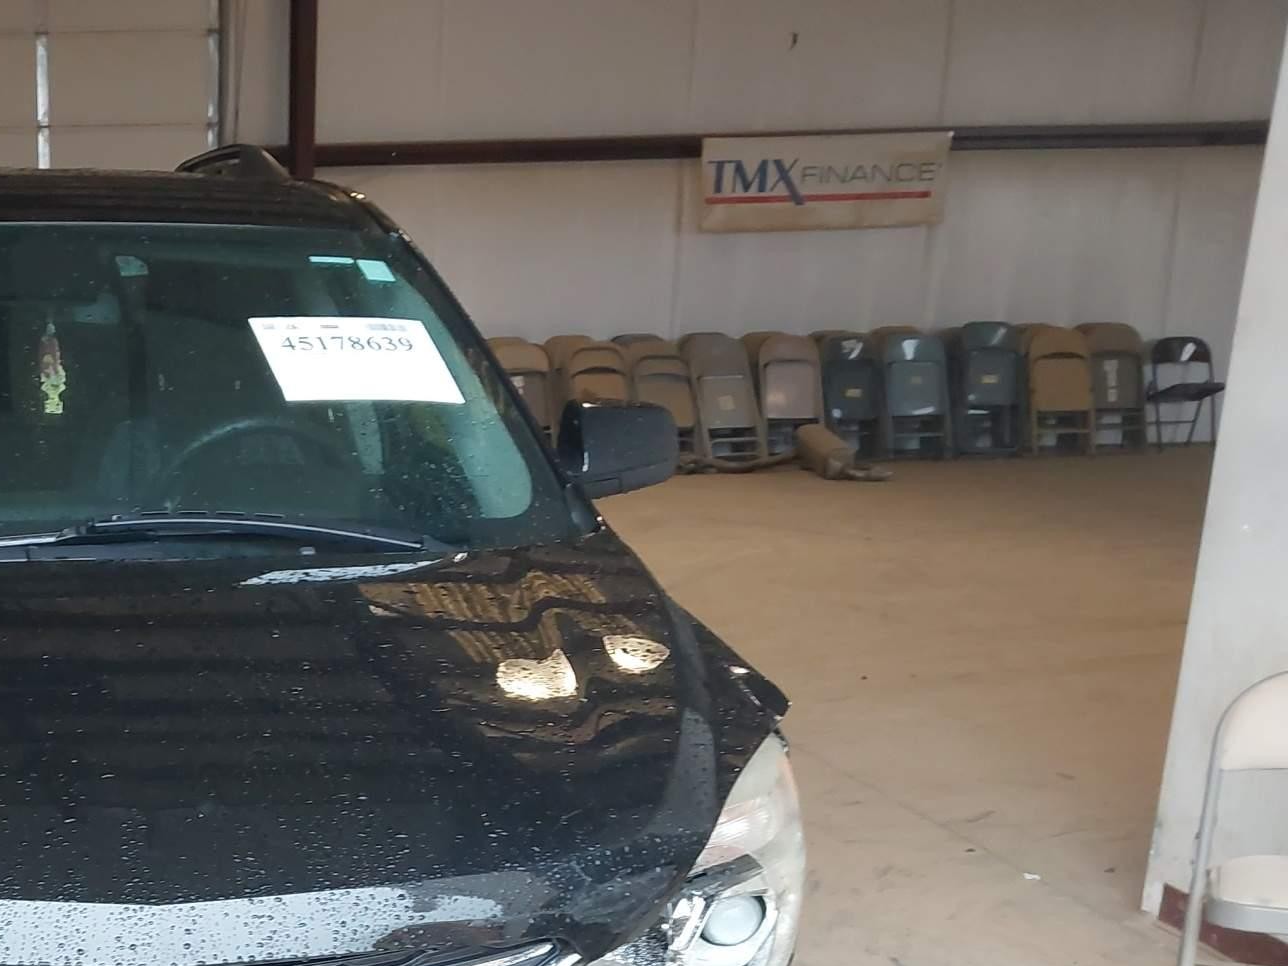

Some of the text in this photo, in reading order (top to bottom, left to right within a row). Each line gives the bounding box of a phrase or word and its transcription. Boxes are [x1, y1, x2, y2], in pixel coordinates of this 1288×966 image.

[707, 157, 935, 206] TMX FINANCE
[281, 336, 414, 352] 45178639
